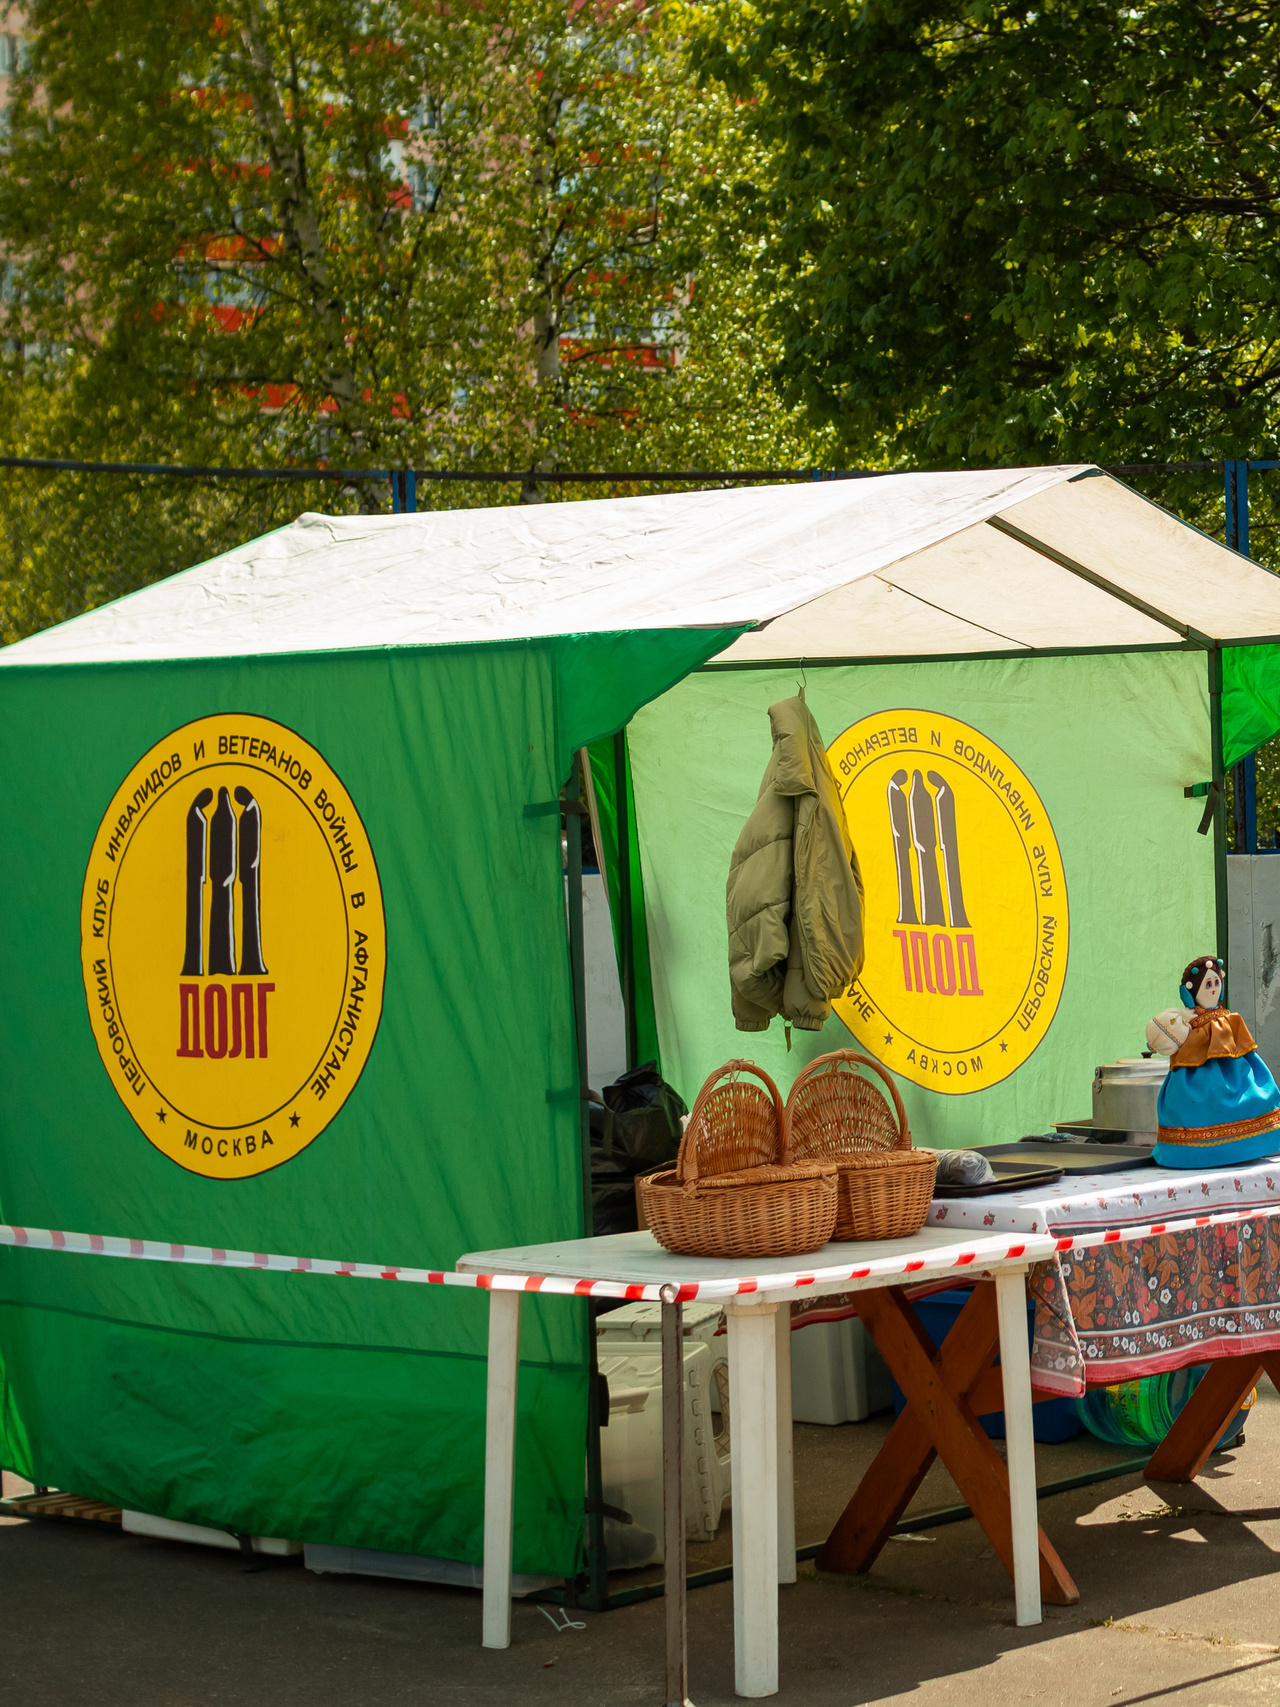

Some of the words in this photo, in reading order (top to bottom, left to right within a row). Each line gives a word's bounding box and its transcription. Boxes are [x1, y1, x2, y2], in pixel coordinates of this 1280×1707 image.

[193, 740, 205, 761] И
[219, 735, 312, 790] ВЕТЕРАНОВ
[105, 753, 182, 862] ИНВАЛИДОВ
[314, 788, 358, 873] ВОЙНЫ
[93, 878, 110, 937] КЛУБ
[351, 891, 365, 909] В
[93, 958, 146, 1096] ПЕРОВСКИЙ
[176, 983, 276, 1059] ДОЛГ
[310, 929, 369, 1101] АФГАНИСТАНЕ
[184, 1129, 274, 1157] МОСКВА
